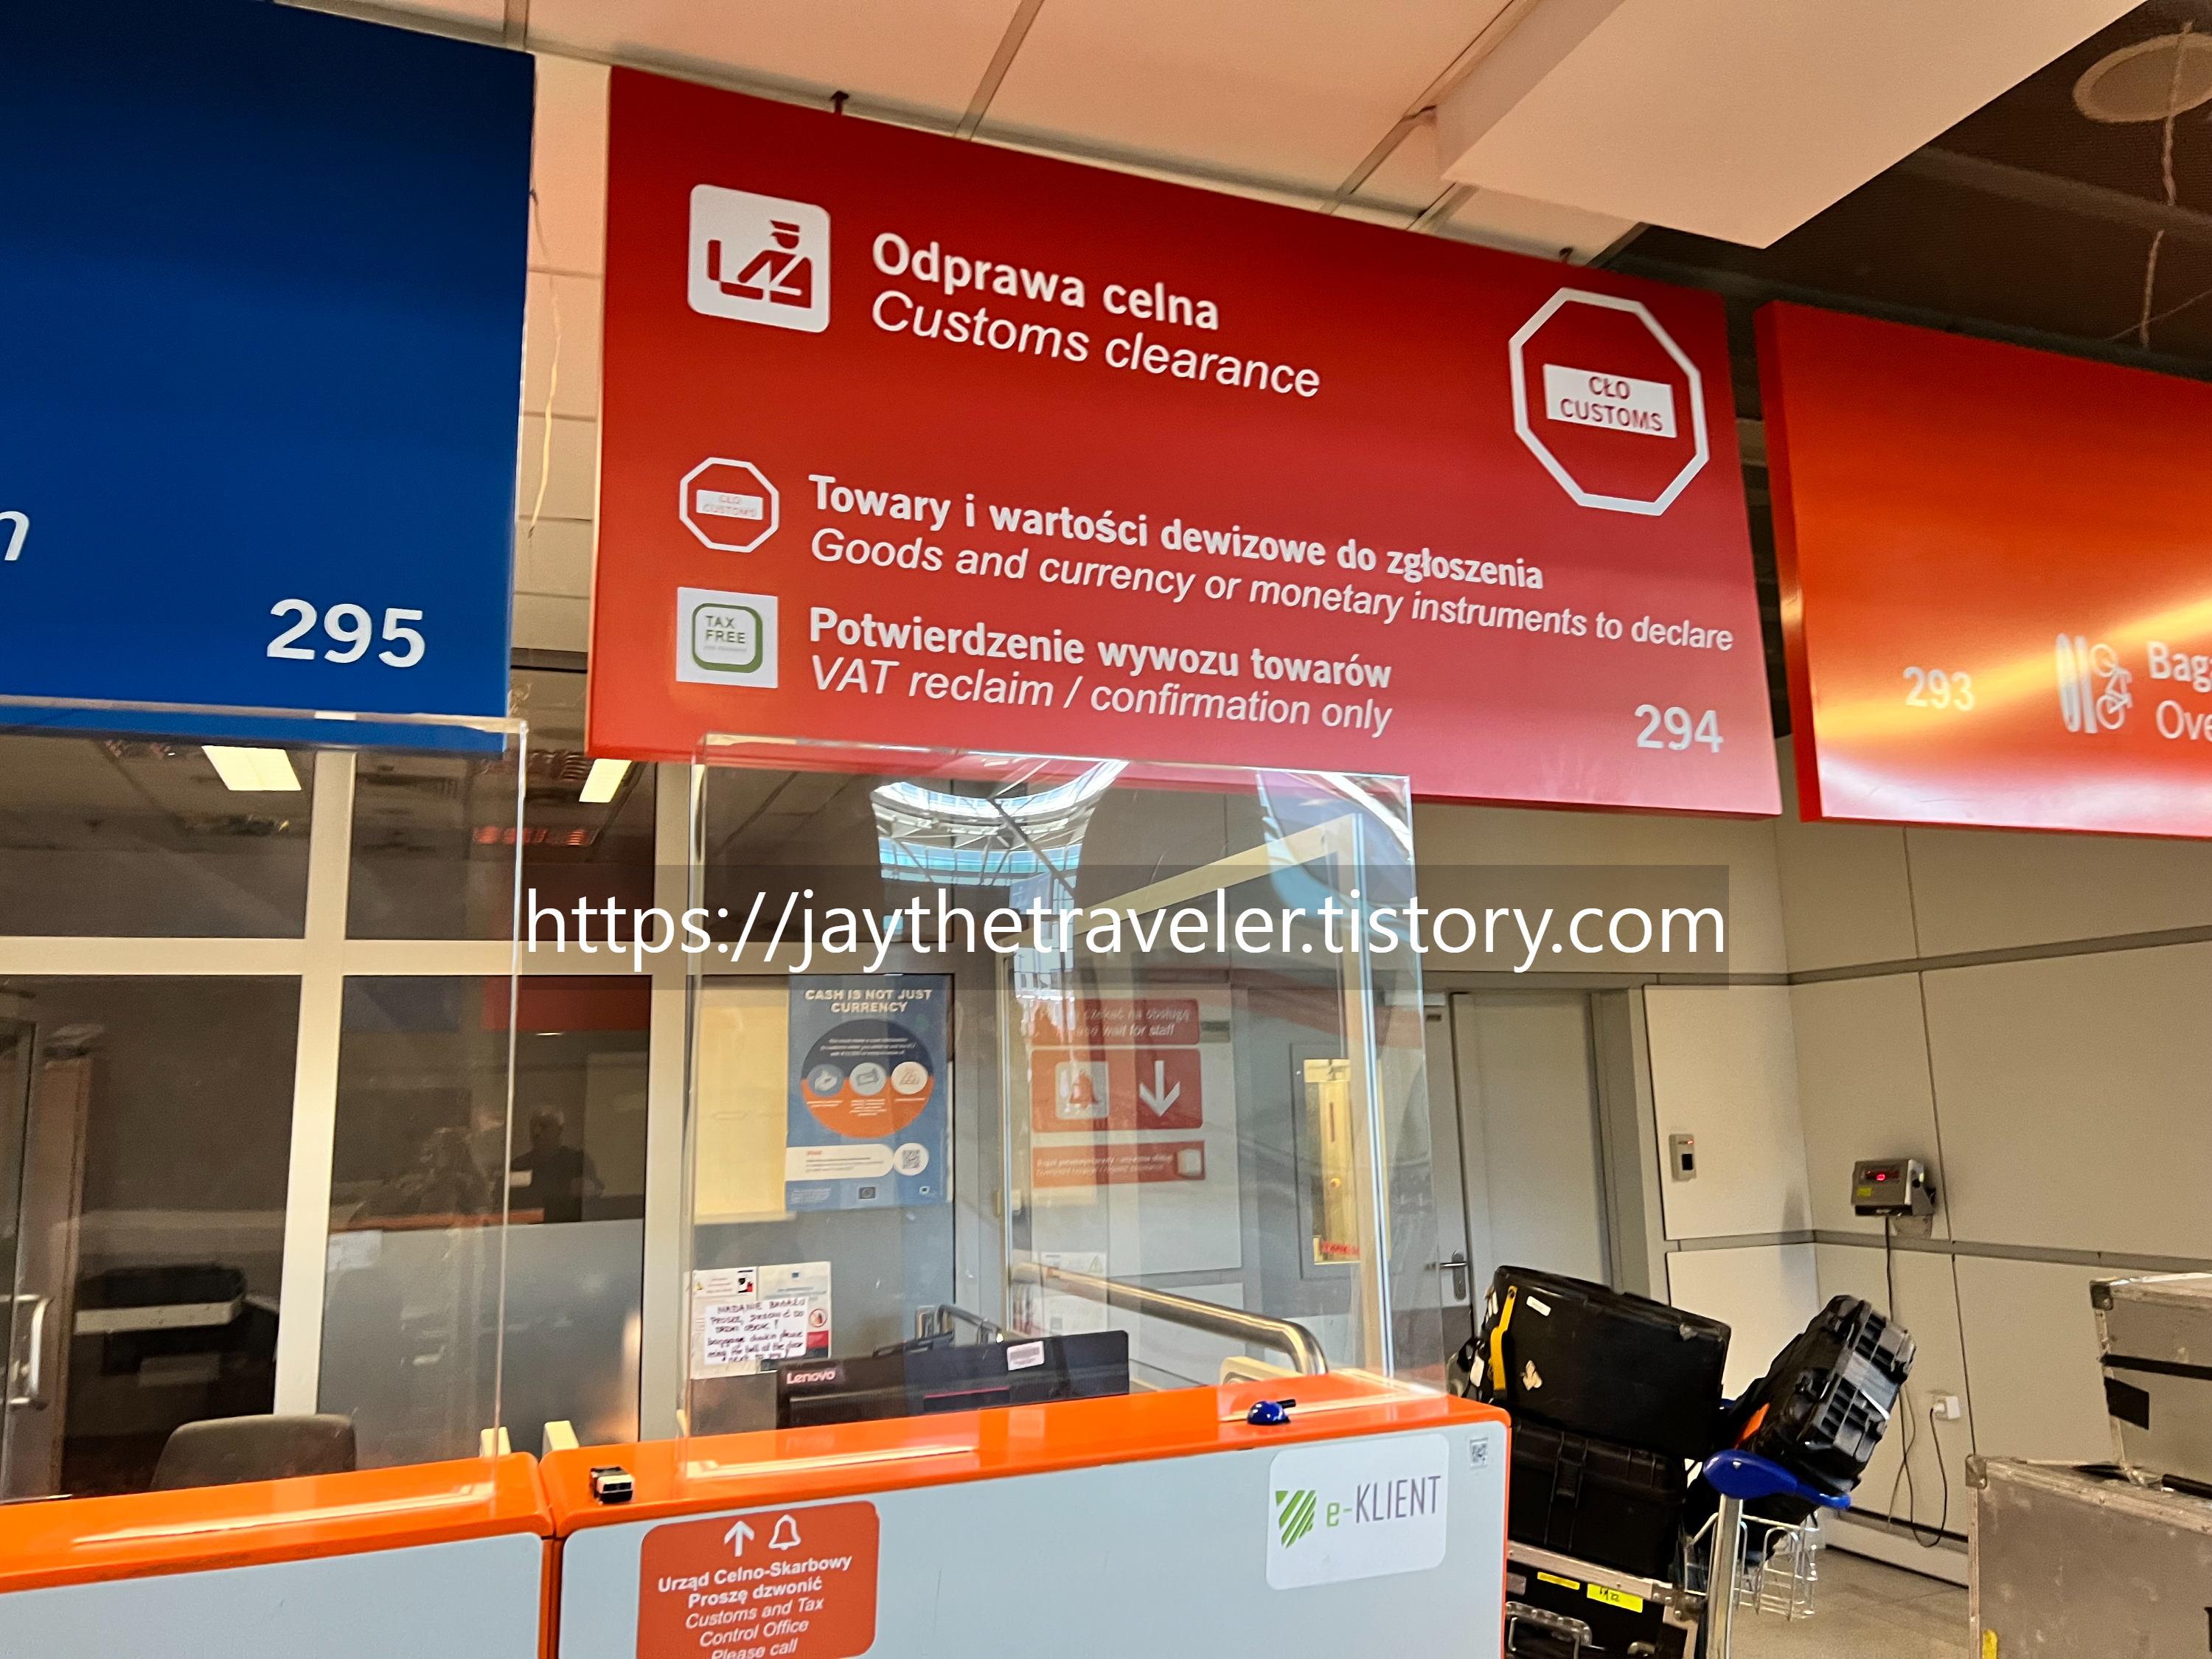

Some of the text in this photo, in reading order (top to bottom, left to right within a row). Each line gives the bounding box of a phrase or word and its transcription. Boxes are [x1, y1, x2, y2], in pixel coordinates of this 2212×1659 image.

[872, 232, 1220, 331] Odprawa celna
[872, 290, 1321, 398] Customs clearance
[1588, 375, 1631, 401] CŁO
[1559, 398, 1663, 433] CUSTOMS
[808, 474, 1544, 589] Towary i wartości dewizowe do zgłoszenia
[811, 528, 1733, 651] Goods and currency or monetary instruments to declare
[267, 599, 425, 667] 295
[706, 615, 735, 629] TAX
[706, 629, 745, 644] FREE
[811, 607, 1392, 688] Potwierdzenie wywozu towarów
[2146, 640, 2212, 694] Bag
[811, 655, 1393, 738] VAT reclaim / confirmation only
[1902, 667, 1976, 712] 293
[1633, 703, 1725, 754] 294
[804, 989, 933, 1001] CASH IS NOT JUST
[830, 1001, 908, 1013] CURRENCY
[1130, 1023, 1147, 1037] for
[1149, 1022, 1176, 1037] staff
[786, 1368, 836, 1385] Lenovo
[1326, 1475, 1442, 1527] e-KLIENT
[658, 1555, 853, 1593] Urząd Celno-Skarbowy
[688, 1576, 823, 1609] Proszę dzwonić
[685, 1596, 825, 1630] Customs and Tax
[699, 1619, 810, 1647] Control Office
[711, 1638, 799, 1659] Please call
